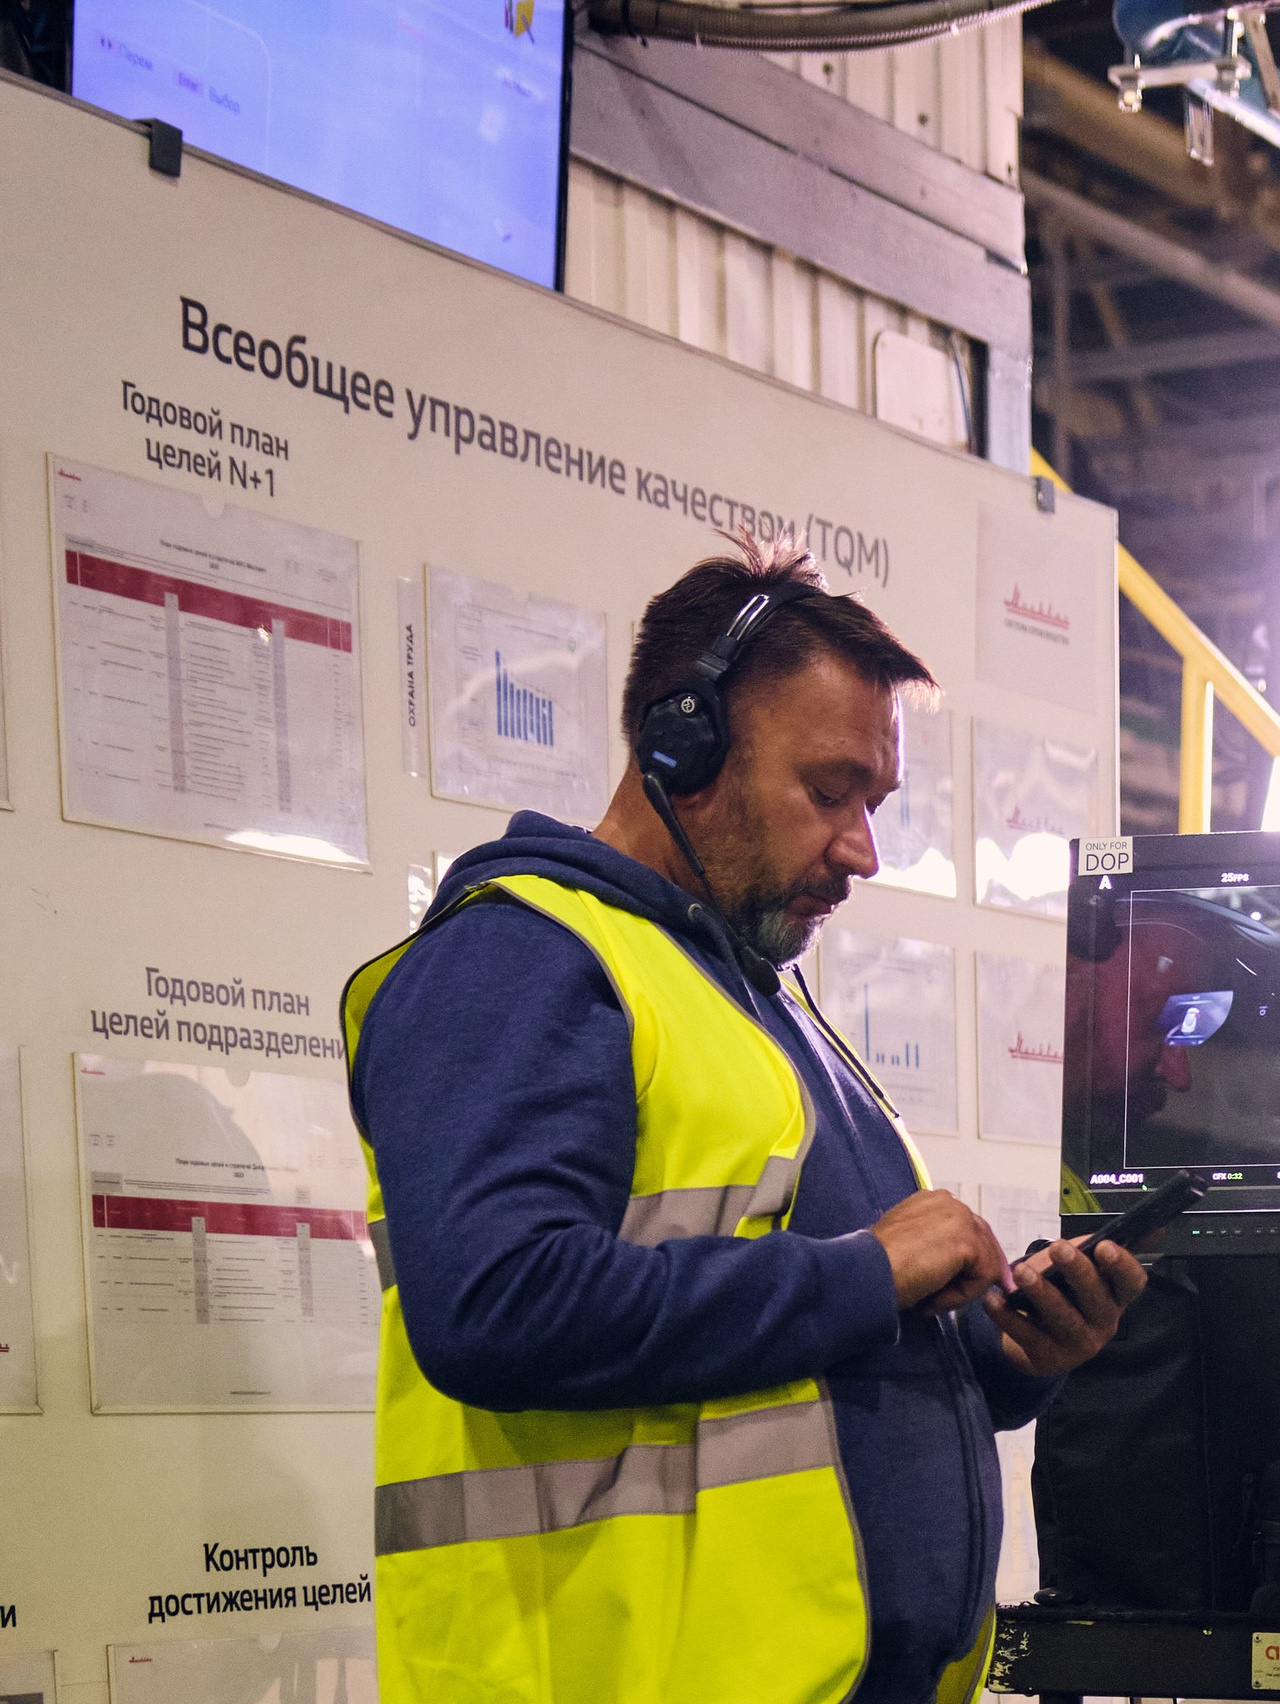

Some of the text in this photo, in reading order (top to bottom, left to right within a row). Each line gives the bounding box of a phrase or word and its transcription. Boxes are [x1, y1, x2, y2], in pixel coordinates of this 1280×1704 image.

[121, 380, 289, 461] Годовой план
[180, 295, 890, 589] Всеобщее управление качеством (TQM)
[145, 438, 275, 497] целей N+1
[405, 624, 416, 728] ОХРАНА ТРУДА
[1085, 841, 1127, 851] ONLY FOR
[1086, 852, 1129, 871] DOP
[1099, 875, 1112, 890] A
[145, 966, 310, 1016] Годовой план
[91, 1009, 170, 1041] целей
[1090, 1173, 1144, 1185] A004_C001
[203, 1543, 318, 1577] Контроль
[147, 1573, 371, 1624] достижения целей
